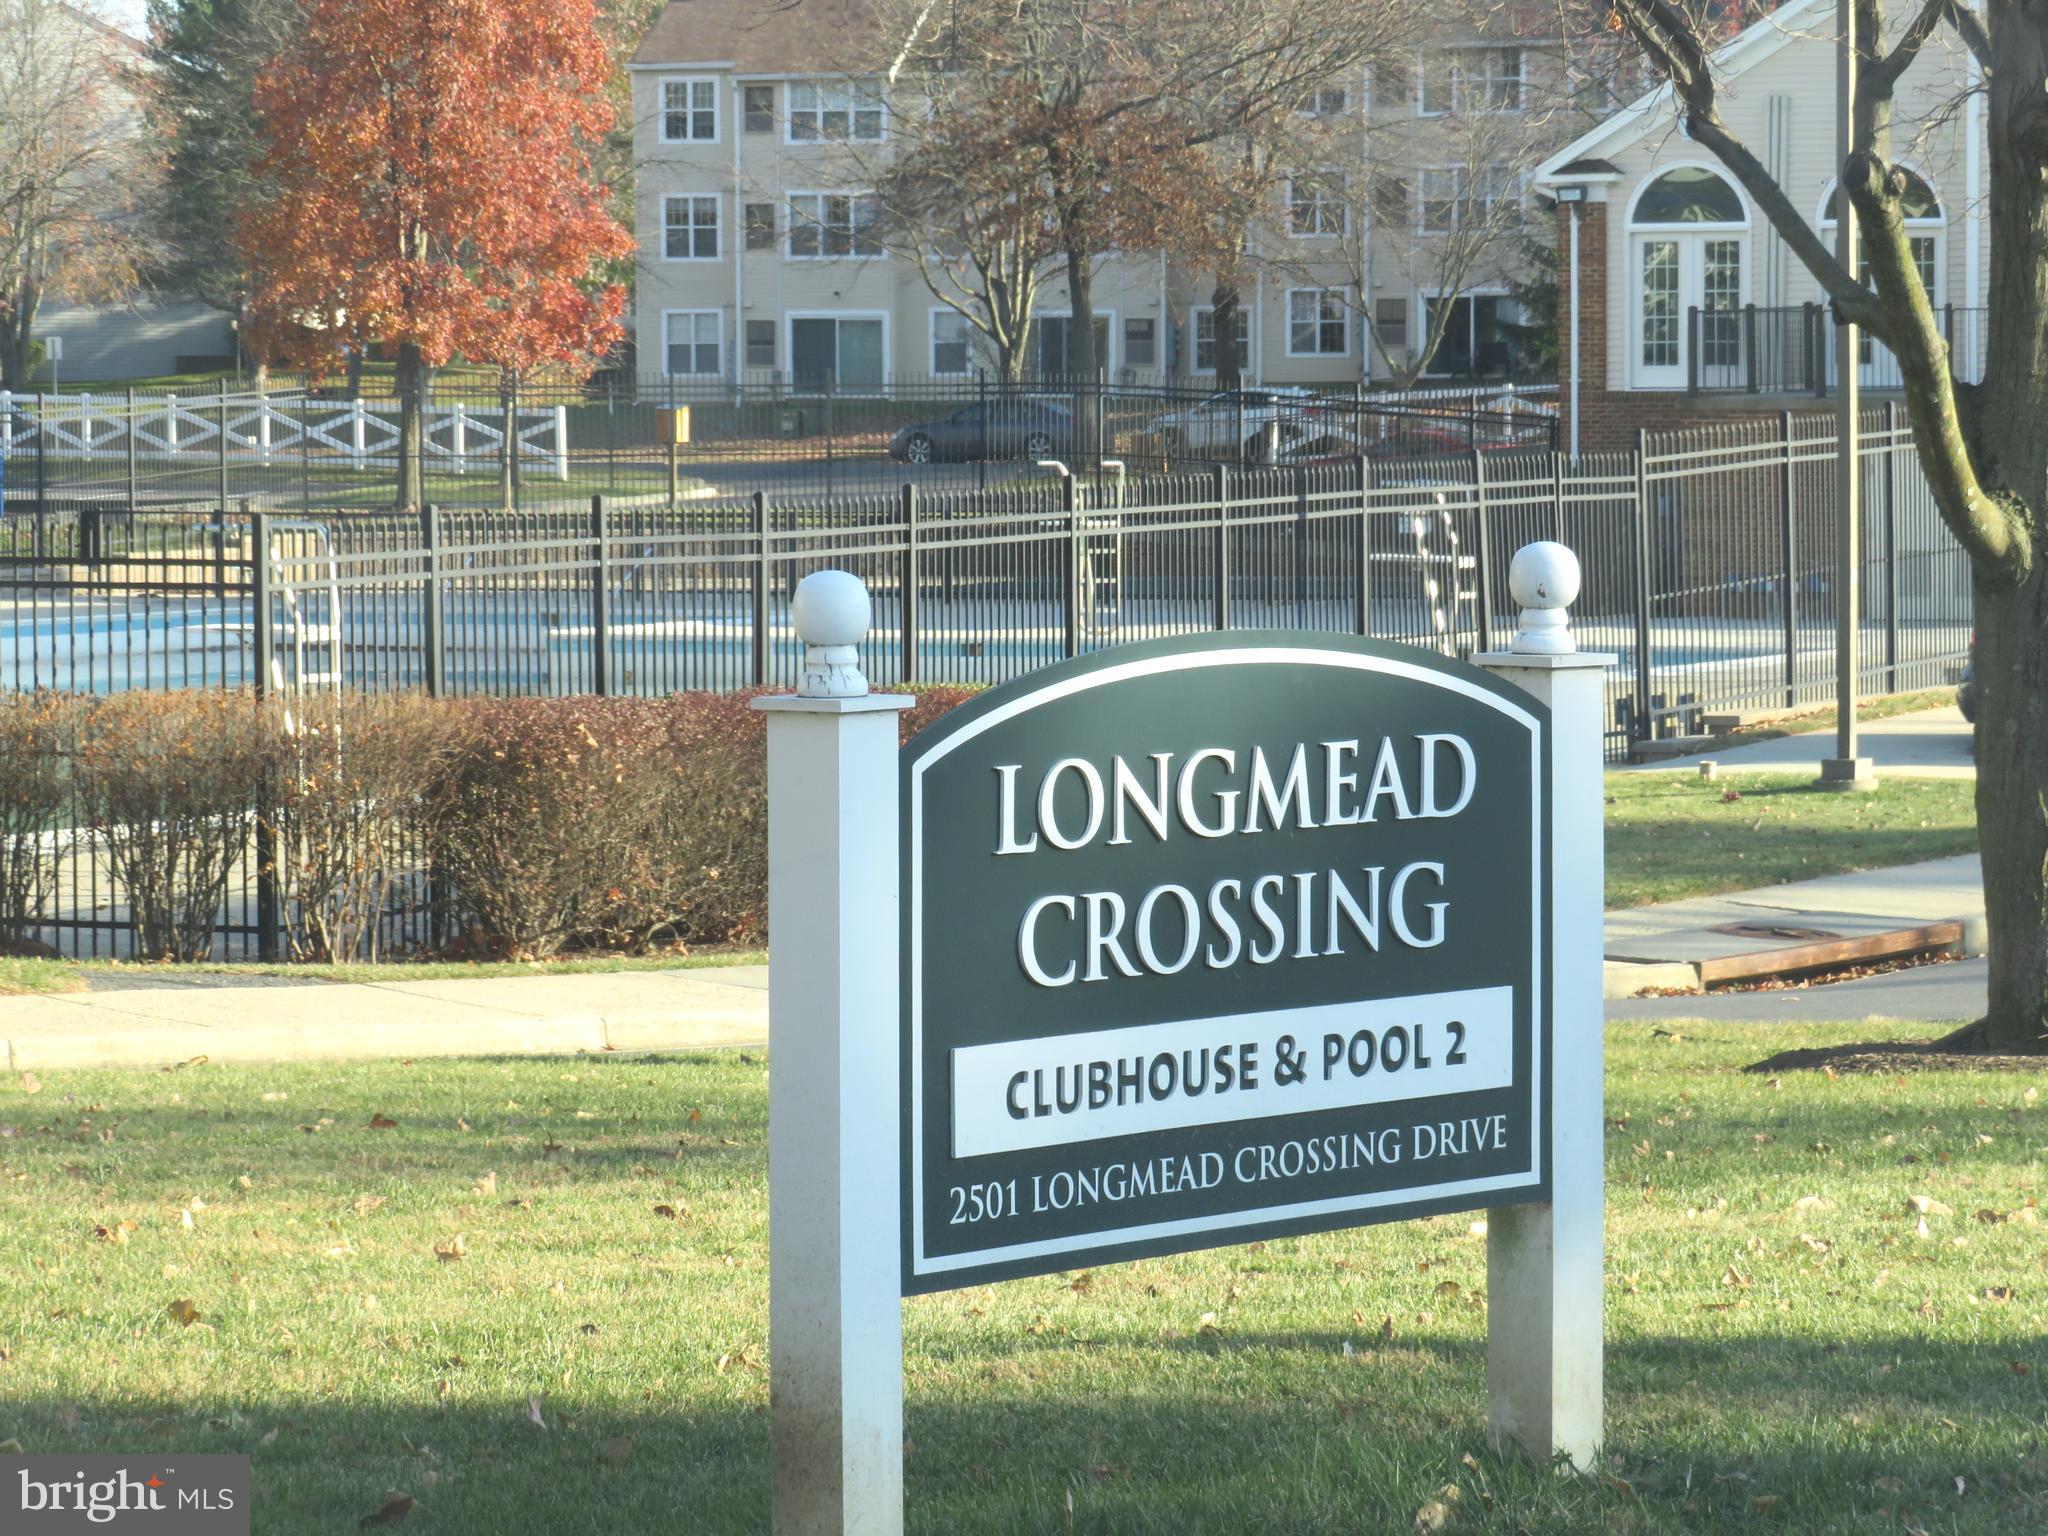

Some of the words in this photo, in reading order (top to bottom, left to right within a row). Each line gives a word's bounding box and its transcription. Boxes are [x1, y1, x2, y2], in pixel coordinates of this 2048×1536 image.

[993, 733, 1477, 855] LONGMEAD
[1018, 862, 1449, 988] CROSSING
[1006, 1042, 1258, 1121] CLUBHOUSE
[1274, 1034, 1307, 1085] &
[1323, 1023, 1432, 1081] POOL
[1446, 1020, 1468, 1065] 2
[949, 1179, 1019, 1225] 2501
[1032, 1153, 1224, 1213] LONGMEAD
[1234, 1128, 1402, 1184] CROSSING
[1412, 1115, 1507, 1161] DRIVE
